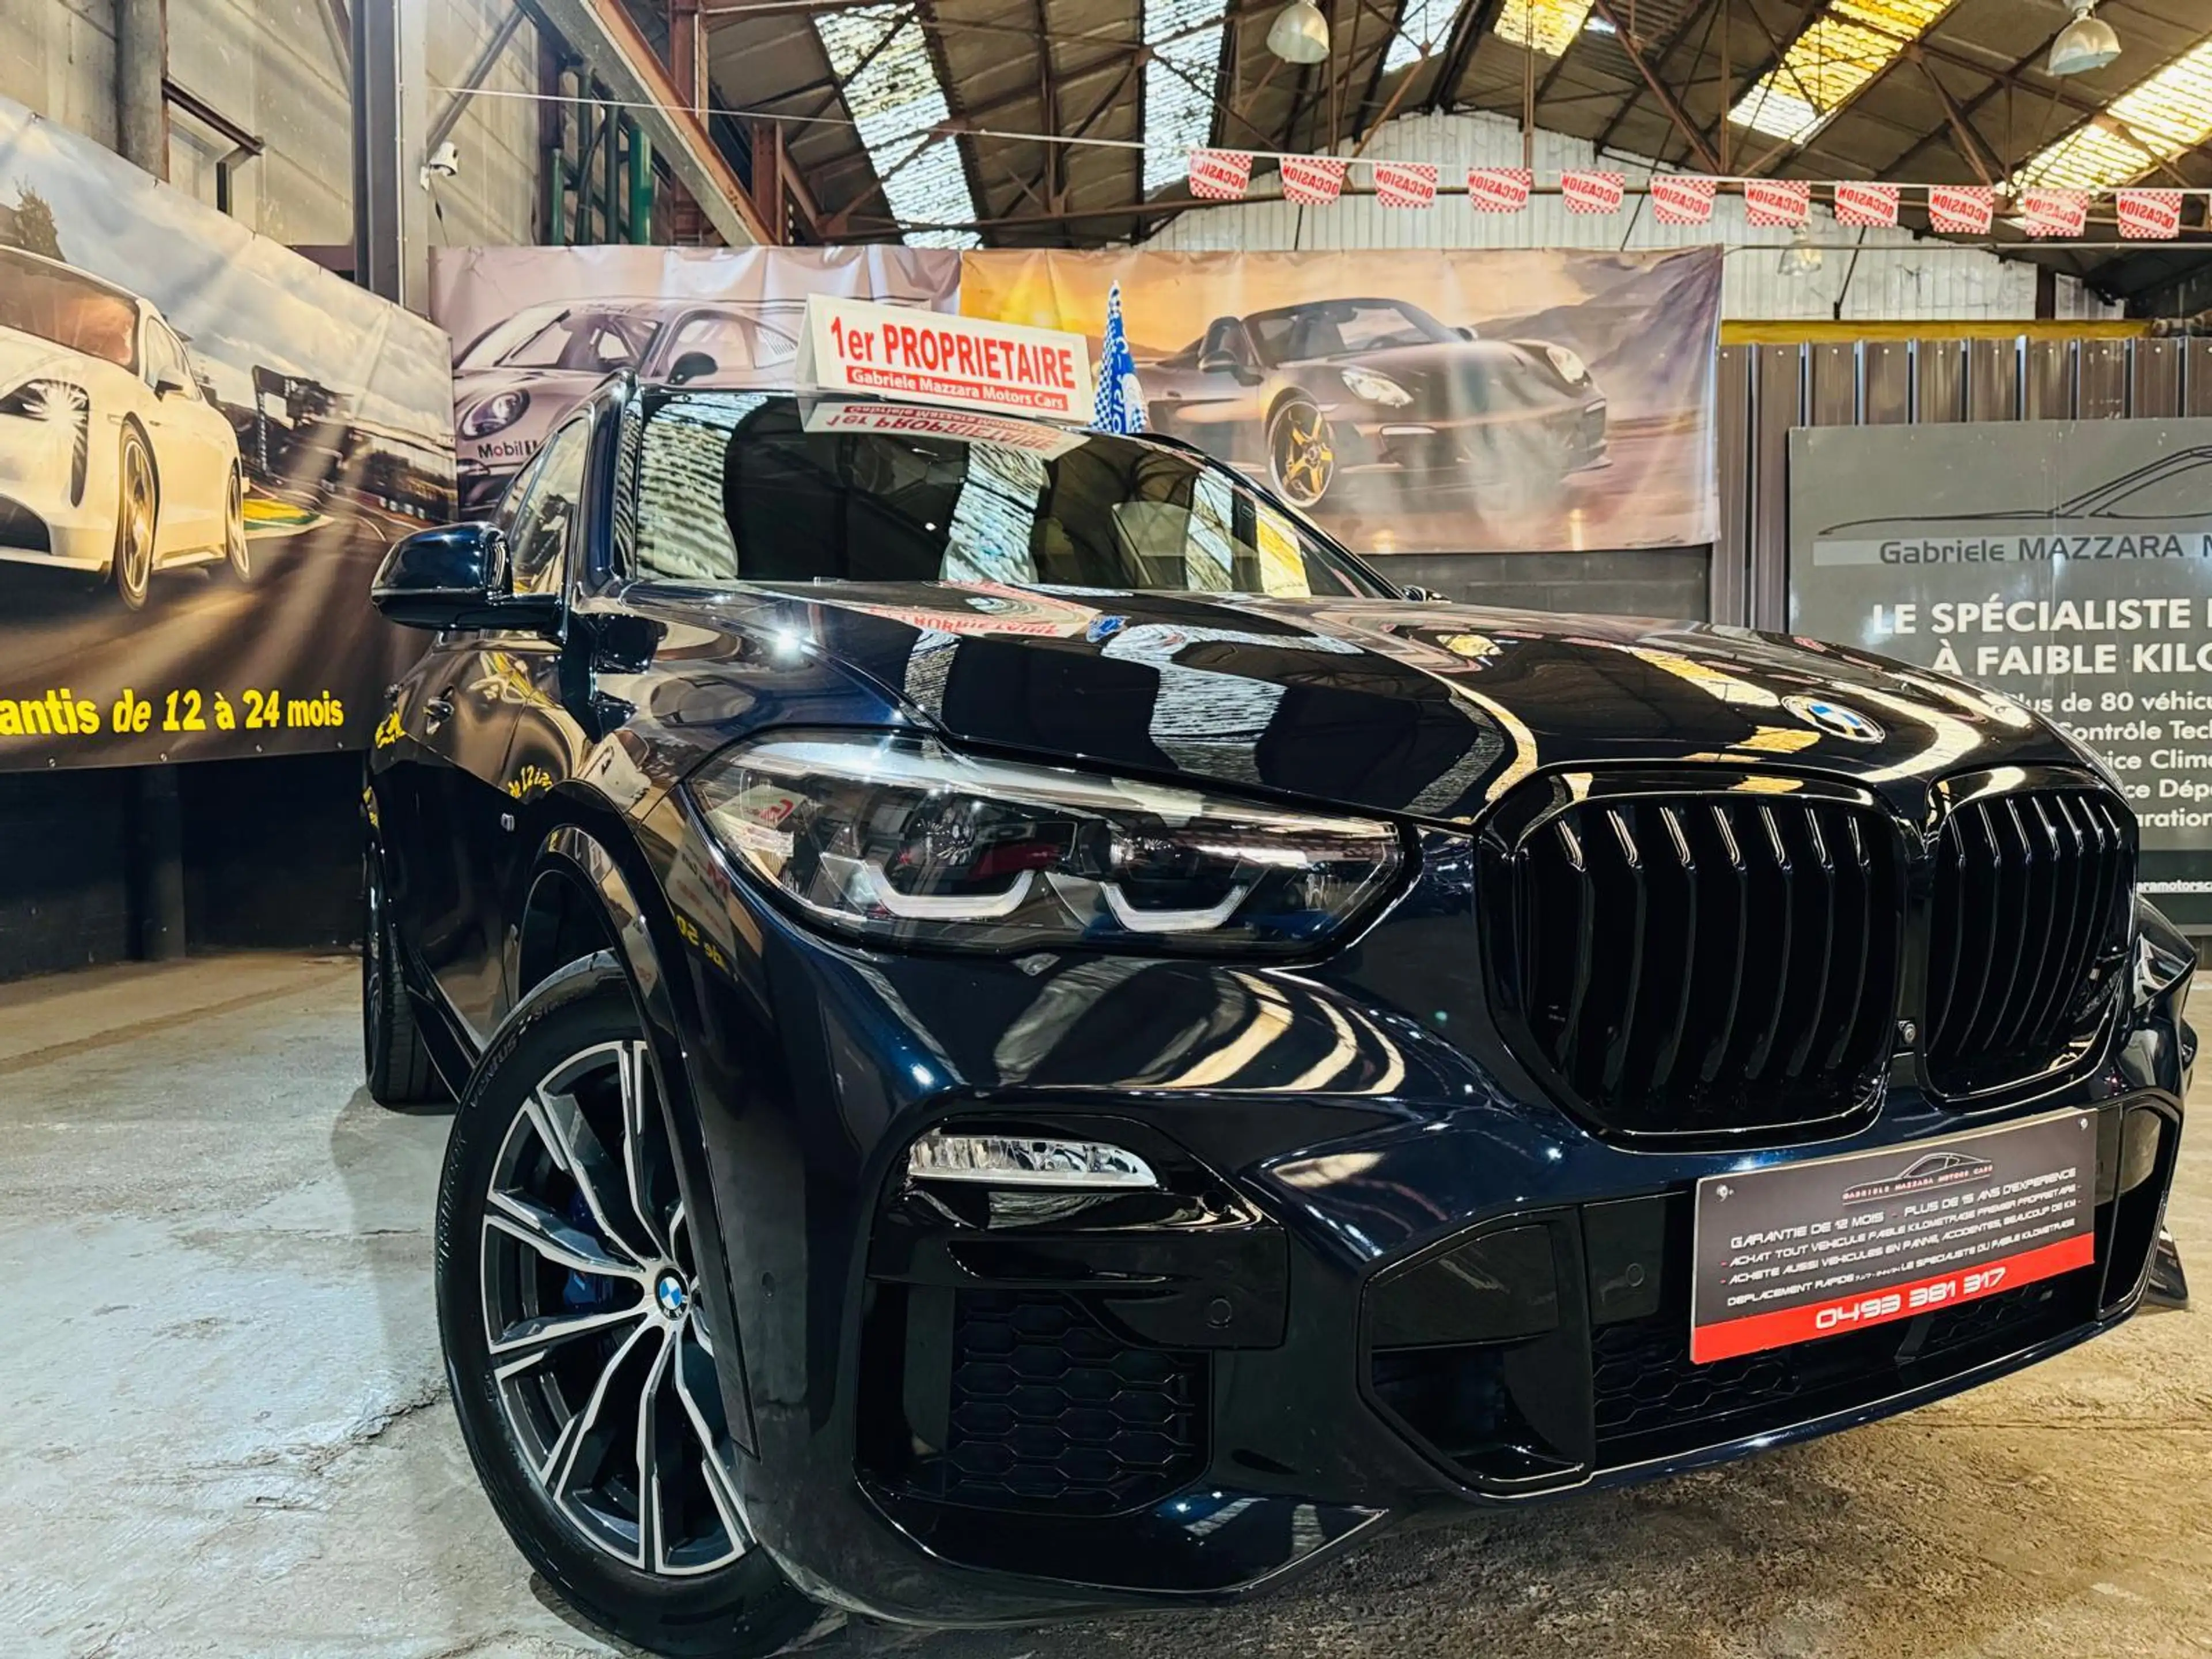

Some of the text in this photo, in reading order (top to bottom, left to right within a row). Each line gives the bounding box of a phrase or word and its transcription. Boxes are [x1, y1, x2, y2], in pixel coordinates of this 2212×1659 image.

[831, 316, 874, 362] 1er
[882, 323, 1076, 389] PROPRIETAIRE
[852, 370, 1065, 410] Gabriele Mazzara Motors Cars
[478, 441, 522, 459] Mobil
[1880, 539, 2005, 564] Gabriele
[2019, 535, 2184, 561] MAZZARA
[1873, 604, 1916, 634] LE
[1931, 593, 2191, 634] SPÉCIALISTE
[1932, 639, 1962, 676] À
[1977, 643, 2116, 676] FAIBLE
[0, 688, 344, 734] antis de 12 à 24 mois
[2061, 692, 2092, 712] de
[2100, 692, 2134, 711] 80
[2059, 720, 2212, 741] ontrôle Tec
[2150, 749, 2212, 769] Clim
[2158, 779, 2212, 802] Dép
[1729, 1251, 1772, 1267] ACHAT
[1775, 1244, 1809, 1259] TOUT
[1811, 1233, 1866, 1252] VEHICULE
[1907, 1210, 1975, 1232] KILOMETRAGE
[1977, 1199, 2016, 1217] PREMIER
[1731, 1225, 1808, 1249] GARANTIE
[1810, 1221, 1831, 1235] DE
[1835, 1218, 1848, 1230] 12
[1851, 1211, 1884, 1228] MOIS
[1904, 1200, 1938, 1217] PLUS
[1942, 1196, 1959, 1209] DE
[1962, 1192, 1975, 1205] 15
[1978, 1184, 2001, 1202] ANS
[1729, 1267, 1780, 1285] ACHETE
[1783, 1259, 1819, 1275] AUSSI
[1821, 1247, 1883, 1267] VEHICULES
[1885, 1242, 1900, 1254] EN
[2004, 1205, 2050, 1226] BEAUCOUP
[2051, 1202, 2063, 1212] DE
[1728, 1282, 1813, 1306] DEPLACEMENT
[1815, 1273, 1854, 1290] RAPIDE
[1901, 1260, 1914, 1272] LE
[1915, 1245, 1975, 1268] SPECIALISTE
[1977, 1241, 1990, 1253] DU
[1816, 1267, 2006, 1330] 0493 381 317
